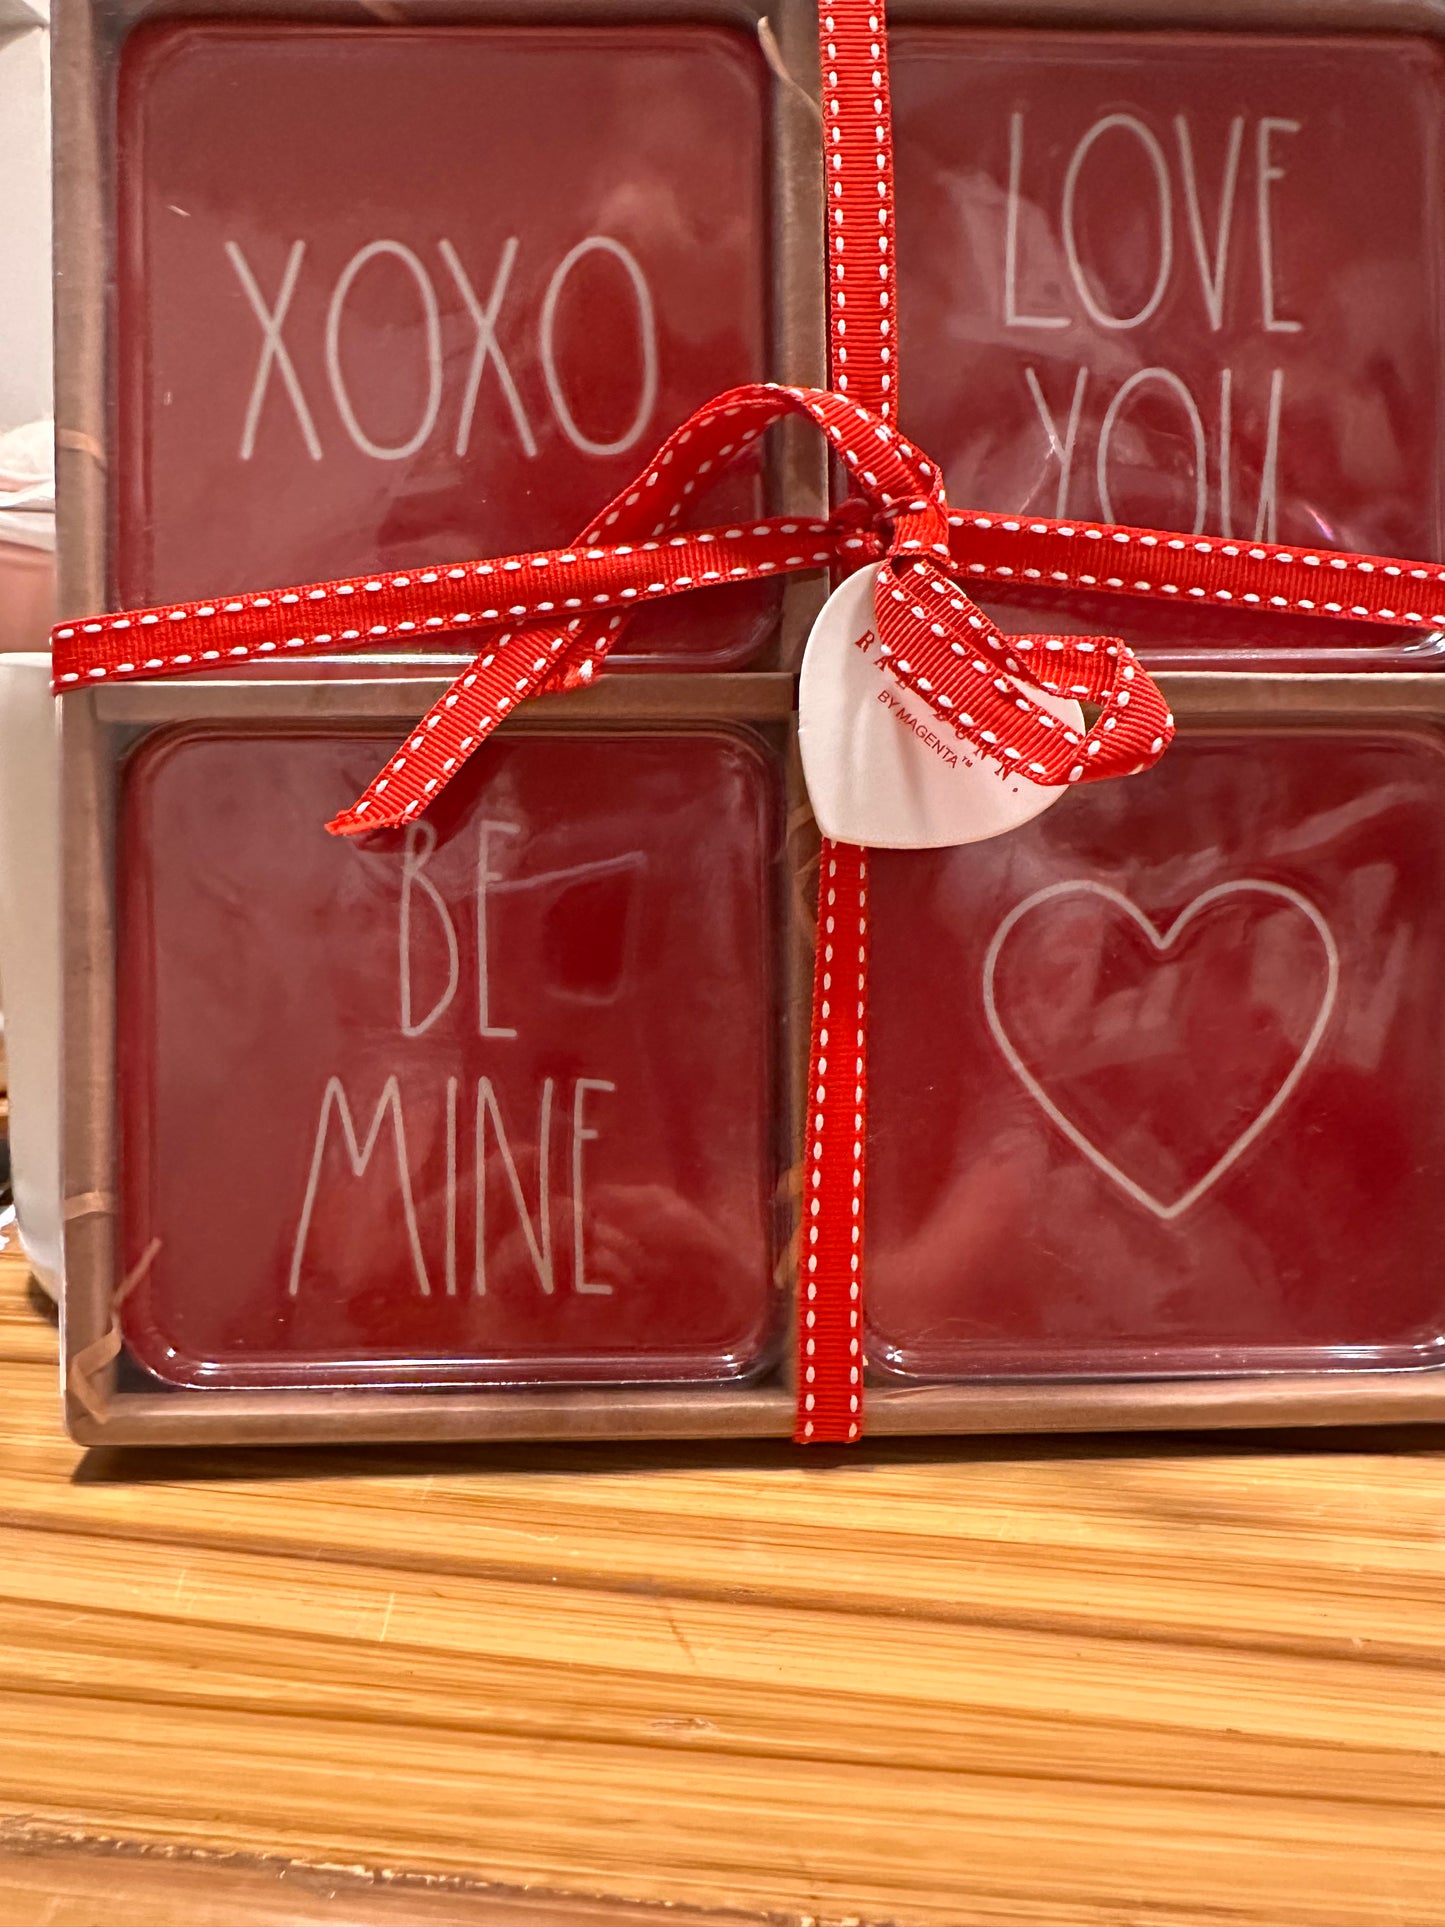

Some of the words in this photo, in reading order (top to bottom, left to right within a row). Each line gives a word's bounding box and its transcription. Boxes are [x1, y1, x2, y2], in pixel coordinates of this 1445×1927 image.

[1005, 112, 1303, 331] LOVE
[224, 236, 658, 460] XOXO
[1025, 366, 1284, 543] YOU
[877, 690, 901, 709] BY
[401, 819, 521, 1038] BE
[288, 1075, 615, 1297] MINE
